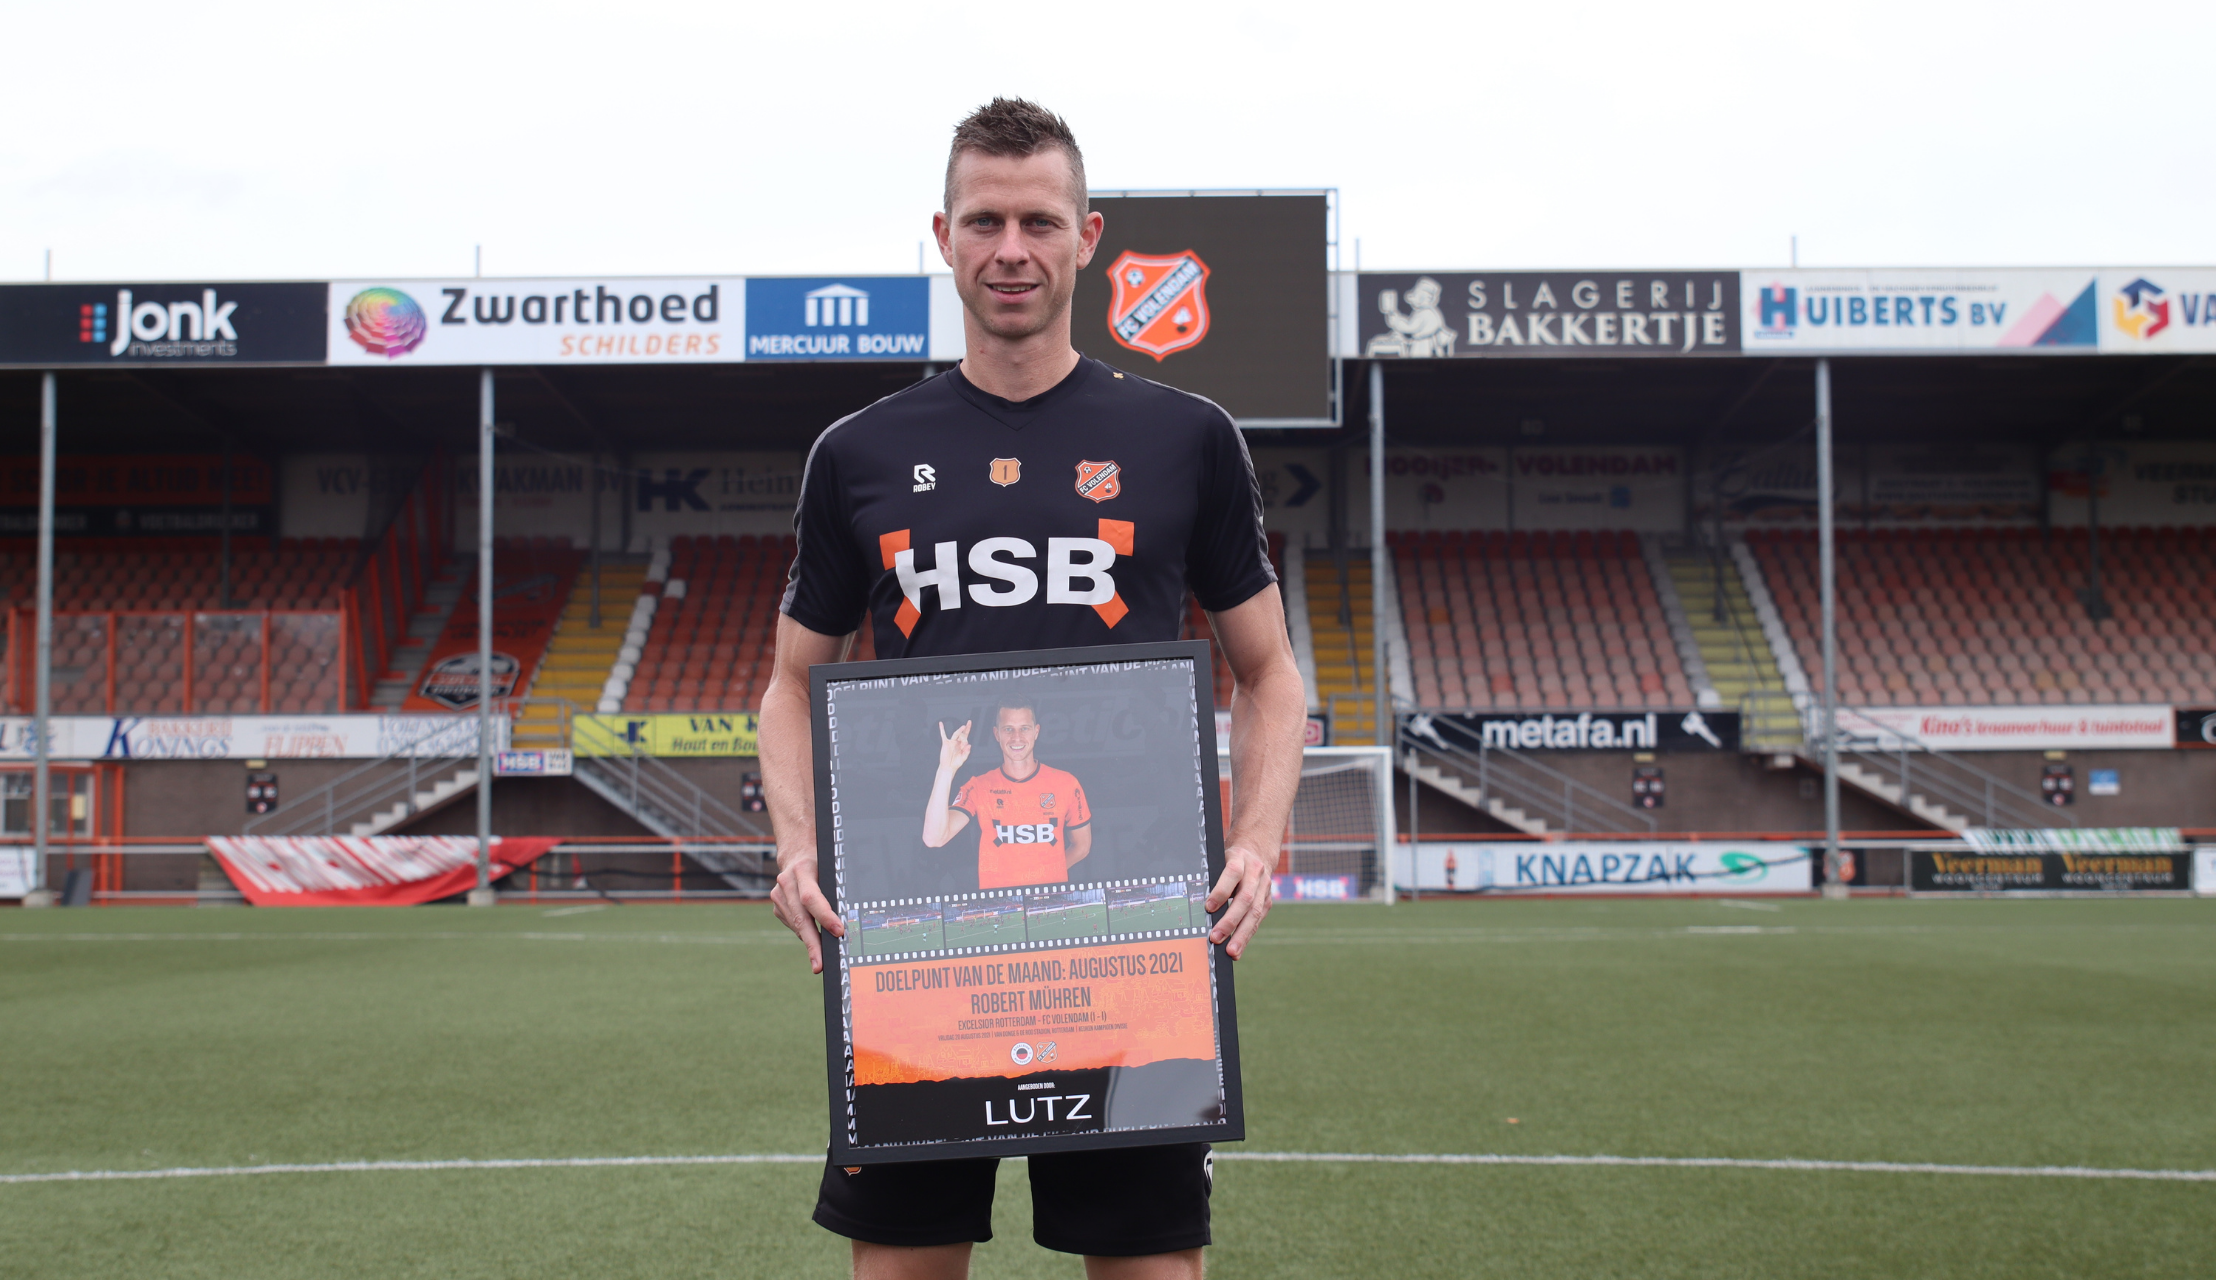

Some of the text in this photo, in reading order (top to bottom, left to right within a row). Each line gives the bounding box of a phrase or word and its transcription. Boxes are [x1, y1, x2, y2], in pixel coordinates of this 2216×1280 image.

[441, 285, 719, 325] Zwarthoed
[1117, 260, 1201, 340] FC VOLENDAM
[1467, 279, 1722, 310] SLAGERIJ
[1758, 286, 2006, 327] HUIBERTS BV
[110, 288, 238, 357] jonk
[1467, 312, 1727, 354] BAKKERTJE
[130, 341, 238, 357] investments
[559, 333, 722, 356] SCHILDERS
[749, 334, 924, 356] MERCUUR BOUW
[1080, 463, 1117, 494] FC VOLENDAM
[1516, 455, 1677, 476] VOLENDAM
[637, 468, 712, 512] HK
[913, 482, 936, 493] ROBEY
[895, 536, 1117, 614] HSB
[689, 718, 733, 733] VAN
[1482, 711, 1658, 749] metafa.nl
[263, 734, 348, 758] FLIPPEN
[672, 738, 707, 752] Hout
[711, 740, 728, 751] en
[995, 823, 1055, 844] HSB
[1516, 854, 1696, 885] KNAPZAK
[1932, 852, 2043, 874] Veerman
[2062, 852, 2173, 874] Veerman
[1295, 879, 1346, 898] HSB
[875, 951, 1184, 993] DOELPUNT VAN DE MAAND: AUGUSTUS 2021
[971, 985, 1092, 1015] ROBERT MÜHREN
[958, 1018, 995, 1031] EXCELSIOR
[995, 1016, 1036, 1028] ROTTERDAM
[1042, 1014, 1051, 1025] FC
[1052, 1011, 1090, 1024] VOLENDAM
[1017, 1083, 1043, 1091] AANGEBODEN
[985, 1093, 1092, 1126] LUTZ
